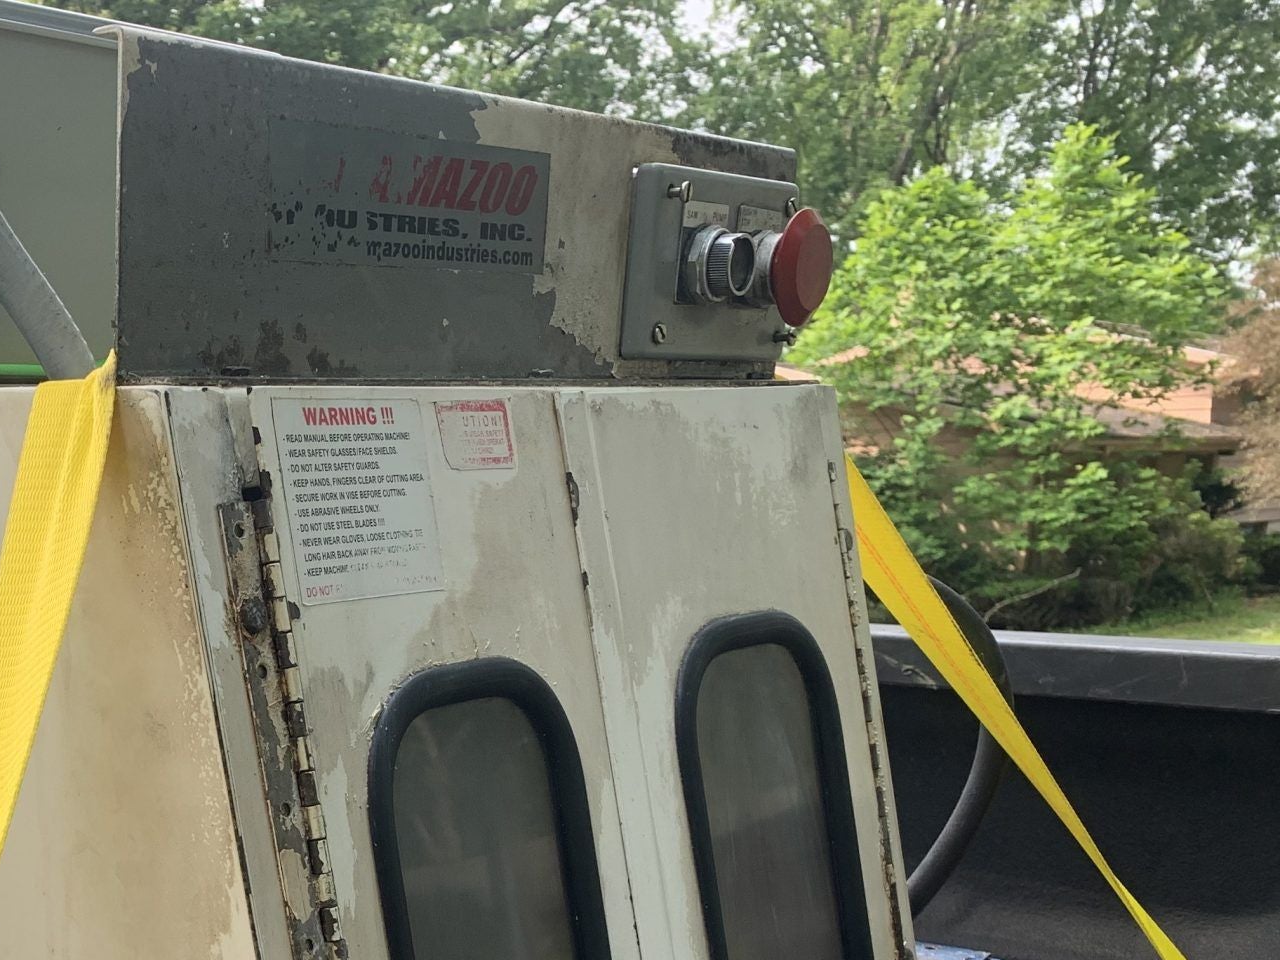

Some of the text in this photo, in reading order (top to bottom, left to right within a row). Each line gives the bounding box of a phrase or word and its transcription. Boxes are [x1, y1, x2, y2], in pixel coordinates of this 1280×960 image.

[479, 221, 533, 243] INC.
[302, 406, 395, 426] WARNING !!!
[285, 434, 302, 443] READ
[303, 434, 328, 443] MANUAL
[329, 433, 352, 442] BEFORE
[353, 432, 384, 441] OPERATING
[288, 448, 306, 458] WEAR
[307, 448, 329, 457] SAFETY
[290, 464, 299, 472] DO
[300, 463, 312, 472] NOT
[314, 462, 332, 471] ALTER
[333, 462, 355, 471] SAFETY
[293, 478, 308, 488] KEEP
[332, 476, 357, 486] FINGERS
[357, 475, 376, 485] CLEAR
[377, 475, 384, 484] OF
[385, 473, 408, 483] CUTTING
[295, 493, 320, 503] SECURE
[320, 492, 338, 501] WORK
[339, 491, 345, 500] IN
[346, 490, 359, 500] VISE
[359, 489, 382, 499] BEFORE
[297, 508, 310, 518] USE
[311, 506, 340, 517] ABRASIVE
[340, 505, 364, 515] WHEELS
[300, 523, 309, 532] DO
[310, 522, 322, 531] NOT
[323, 521, 335, 530] USE
[336, 520, 354, 530] STEEL
[354, 518, 377, 528] BLADES
[302, 537, 322, 547] NEVER
[323, 536, 341, 546] WEAR
[366, 532, 385, 542] LOOSE
[304, 552, 321, 562] LONG
[322, 551, 336, 561] HAIR
[337, 549, 353, 559] BACK
[307, 567, 322, 577] KEEP
[306, 586, 318, 597] DO
[319, 584, 334, 596] NOT
